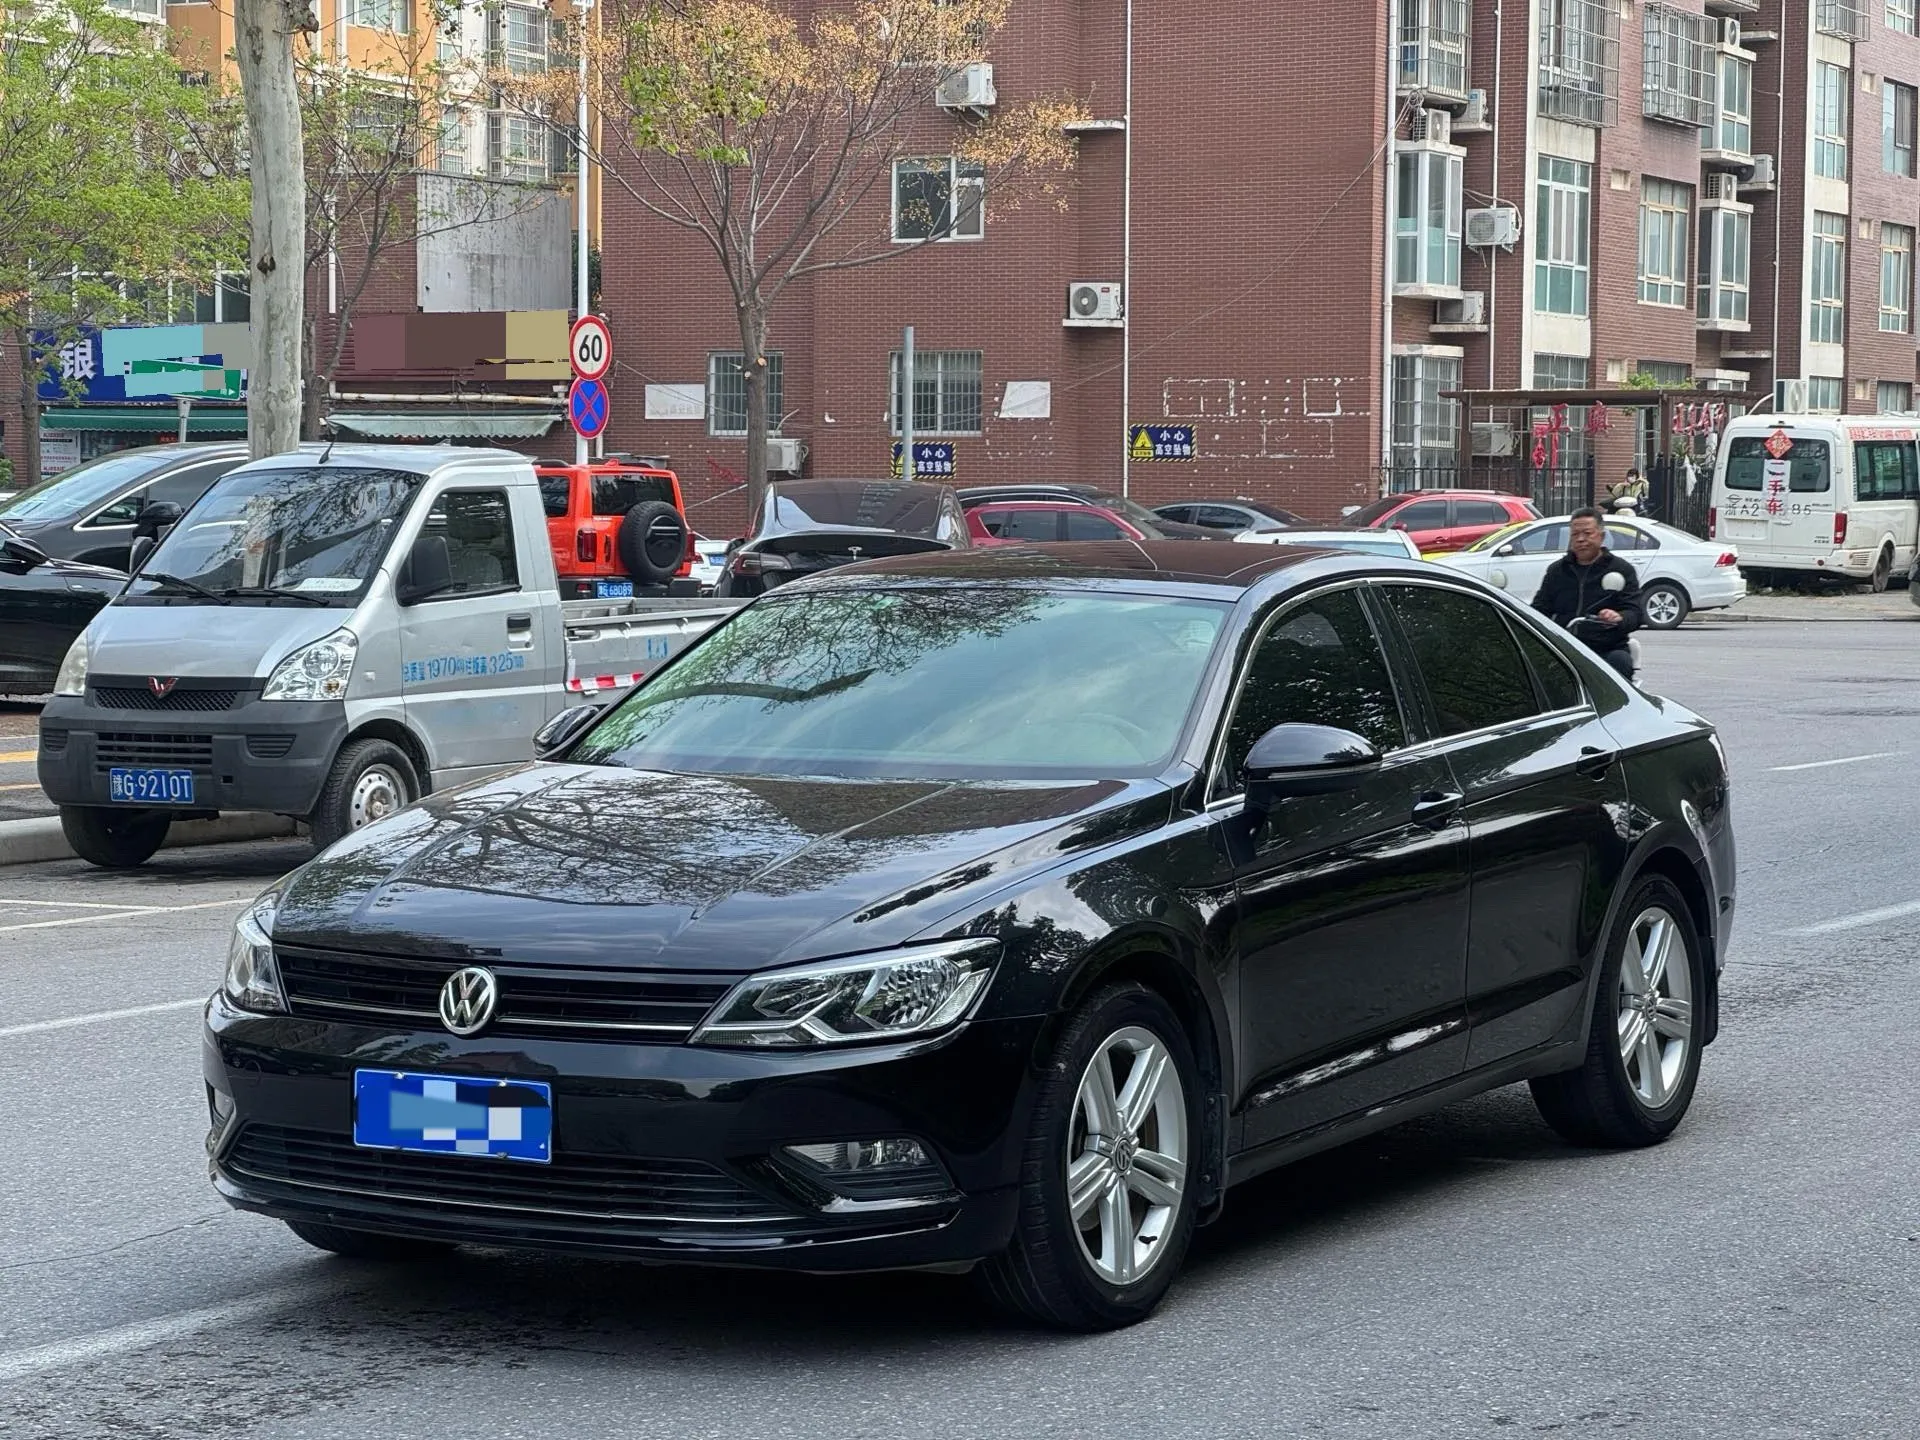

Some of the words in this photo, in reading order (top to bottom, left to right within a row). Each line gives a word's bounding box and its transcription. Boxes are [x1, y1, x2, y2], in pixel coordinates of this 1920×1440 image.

[579, 334, 602, 362] 60
[61, 339, 96, 380] 银
[1160, 430, 1185, 441] 小心
[921, 448, 946, 459] 小心
[1155, 444, 1191, 456] 高空坠物
[917, 461, 952, 473] 高空坠物
[1766, 461, 1786, 516] 二手车
